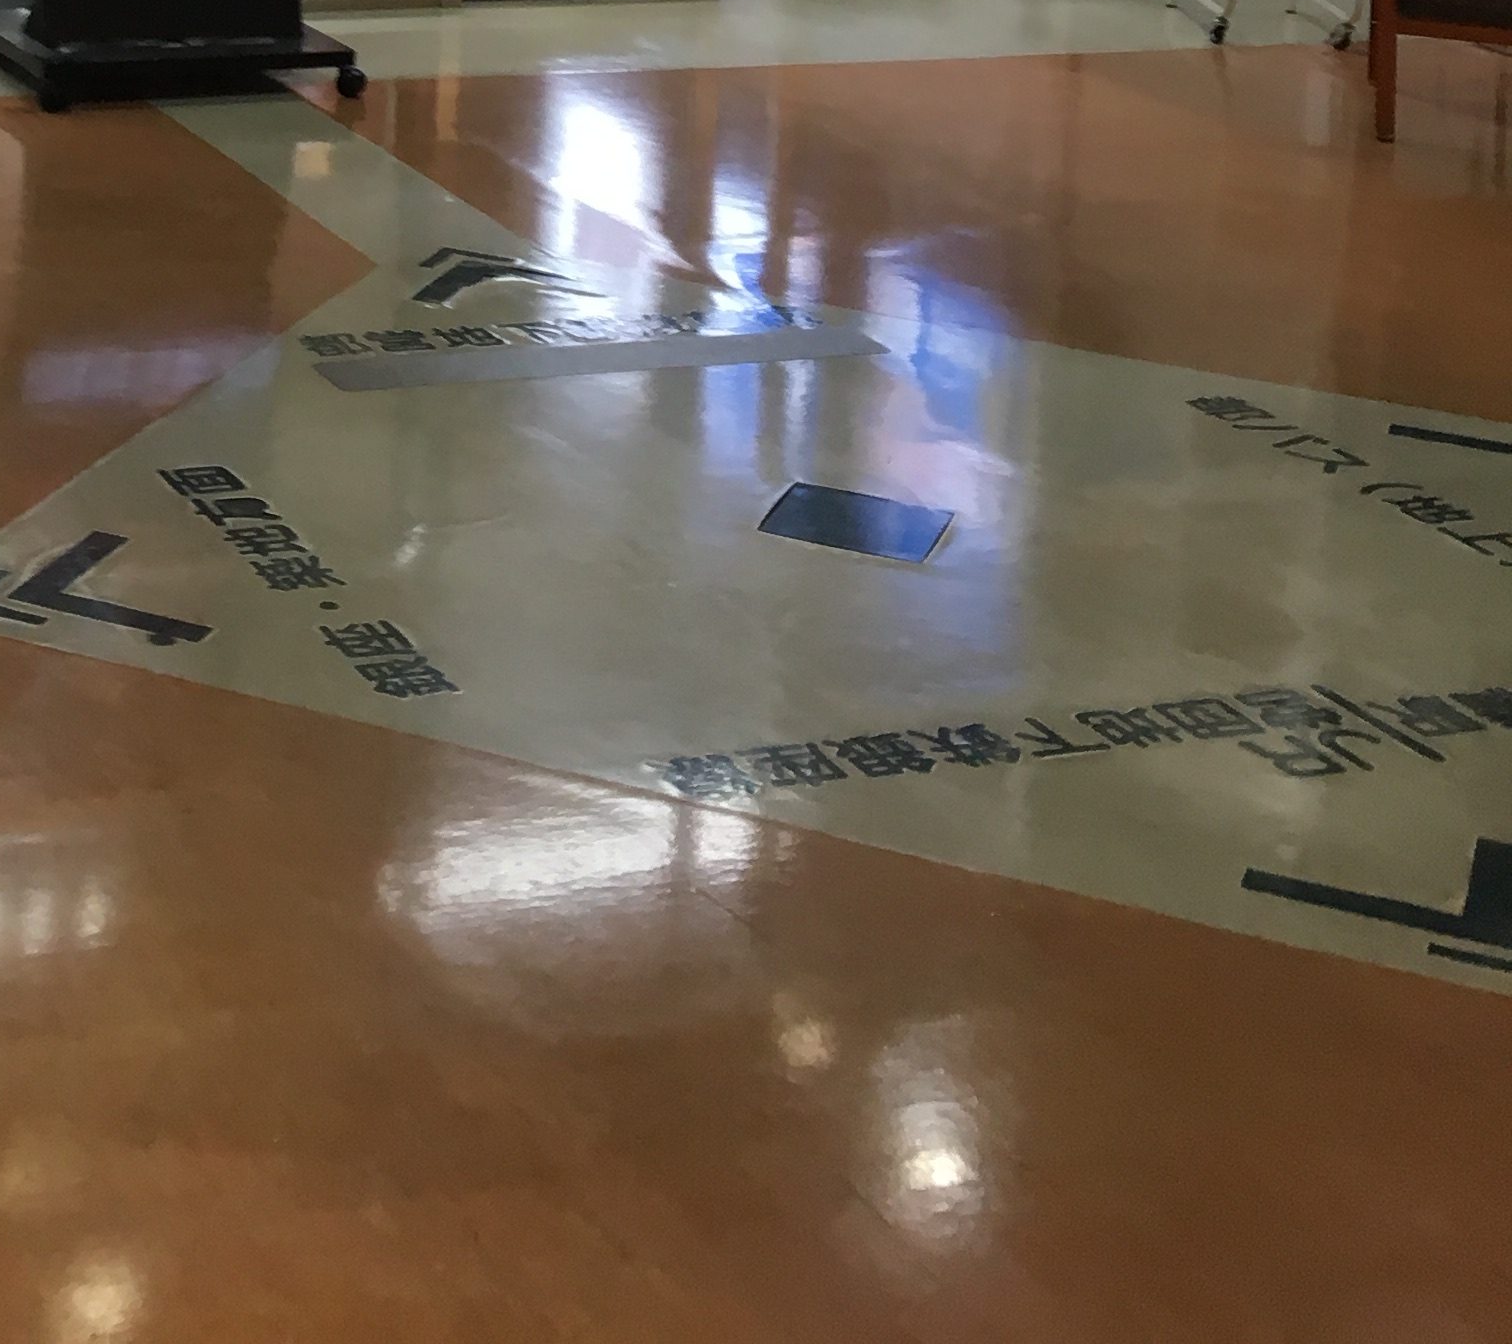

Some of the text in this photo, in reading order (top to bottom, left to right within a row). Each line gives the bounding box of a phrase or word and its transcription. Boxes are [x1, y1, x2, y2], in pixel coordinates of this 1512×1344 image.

[156, 464, 461, 702] 銀座・築地方面
[1238, 727, 1382, 779] JR
